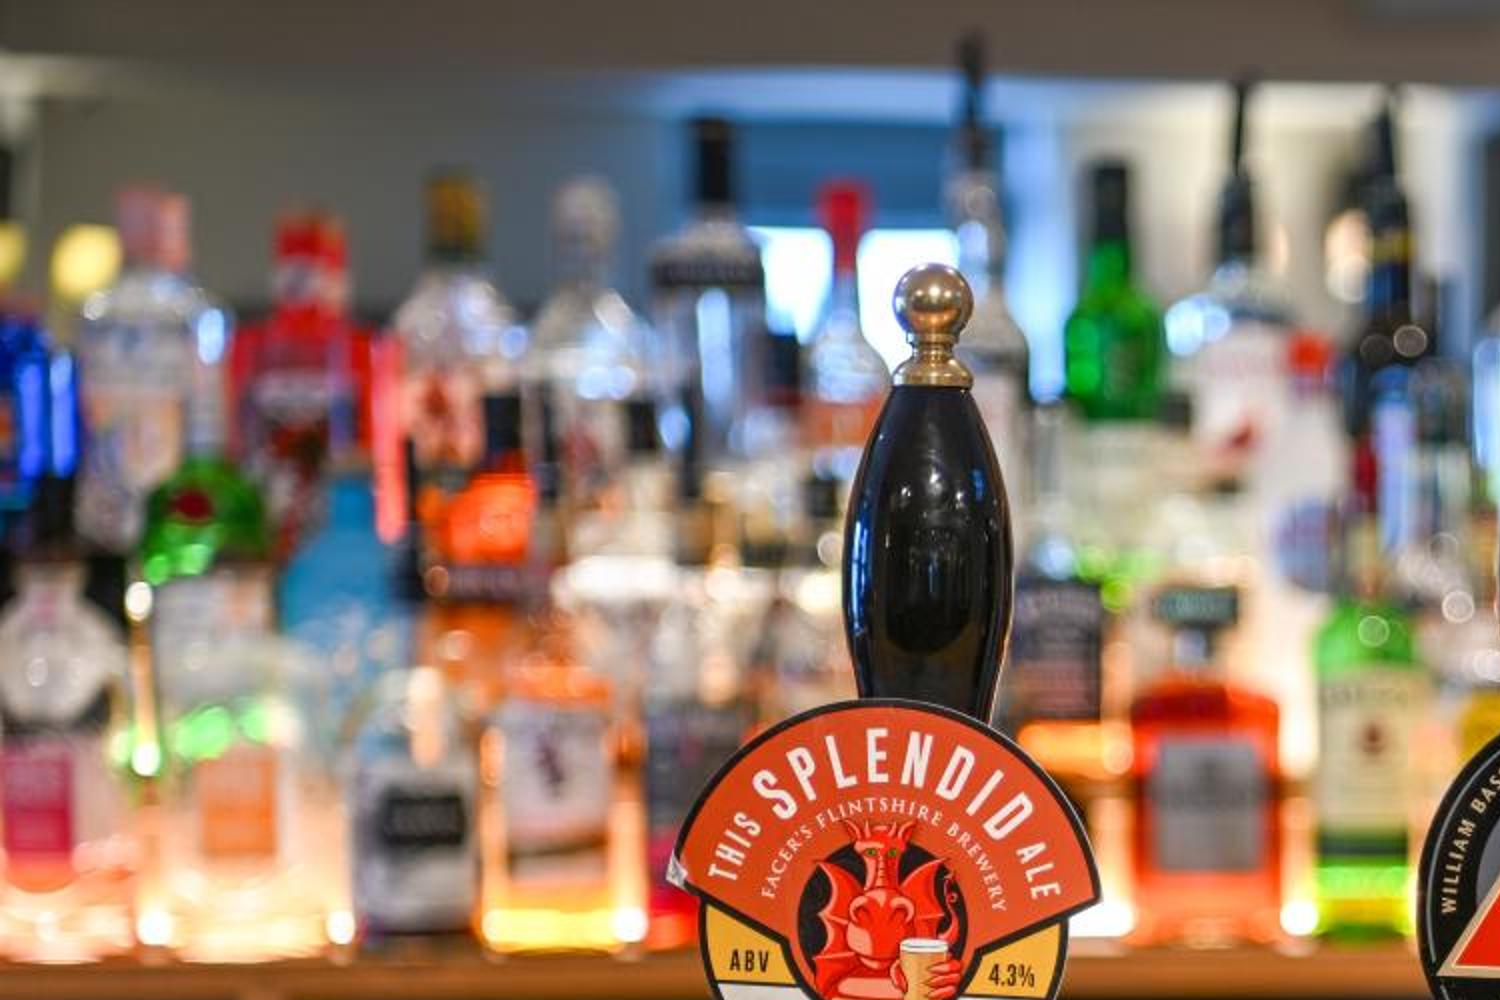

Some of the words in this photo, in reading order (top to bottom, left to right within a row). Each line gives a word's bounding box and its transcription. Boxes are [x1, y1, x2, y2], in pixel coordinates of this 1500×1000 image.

[708, 811, 763, 881] THIS
[752, 727, 1034, 841] SPLENDID
[1015, 841, 1061, 900] ALE
[761, 824, 812, 899] FACER'S
[816, 797, 943, 829] FLINTSHIRE
[946, 821, 1007, 912] BREWERY
[1441, 821, 1476, 914] WILLIAM
[729, 949, 769, 973] ABV
[988, 963, 1036, 988] 4.3%
